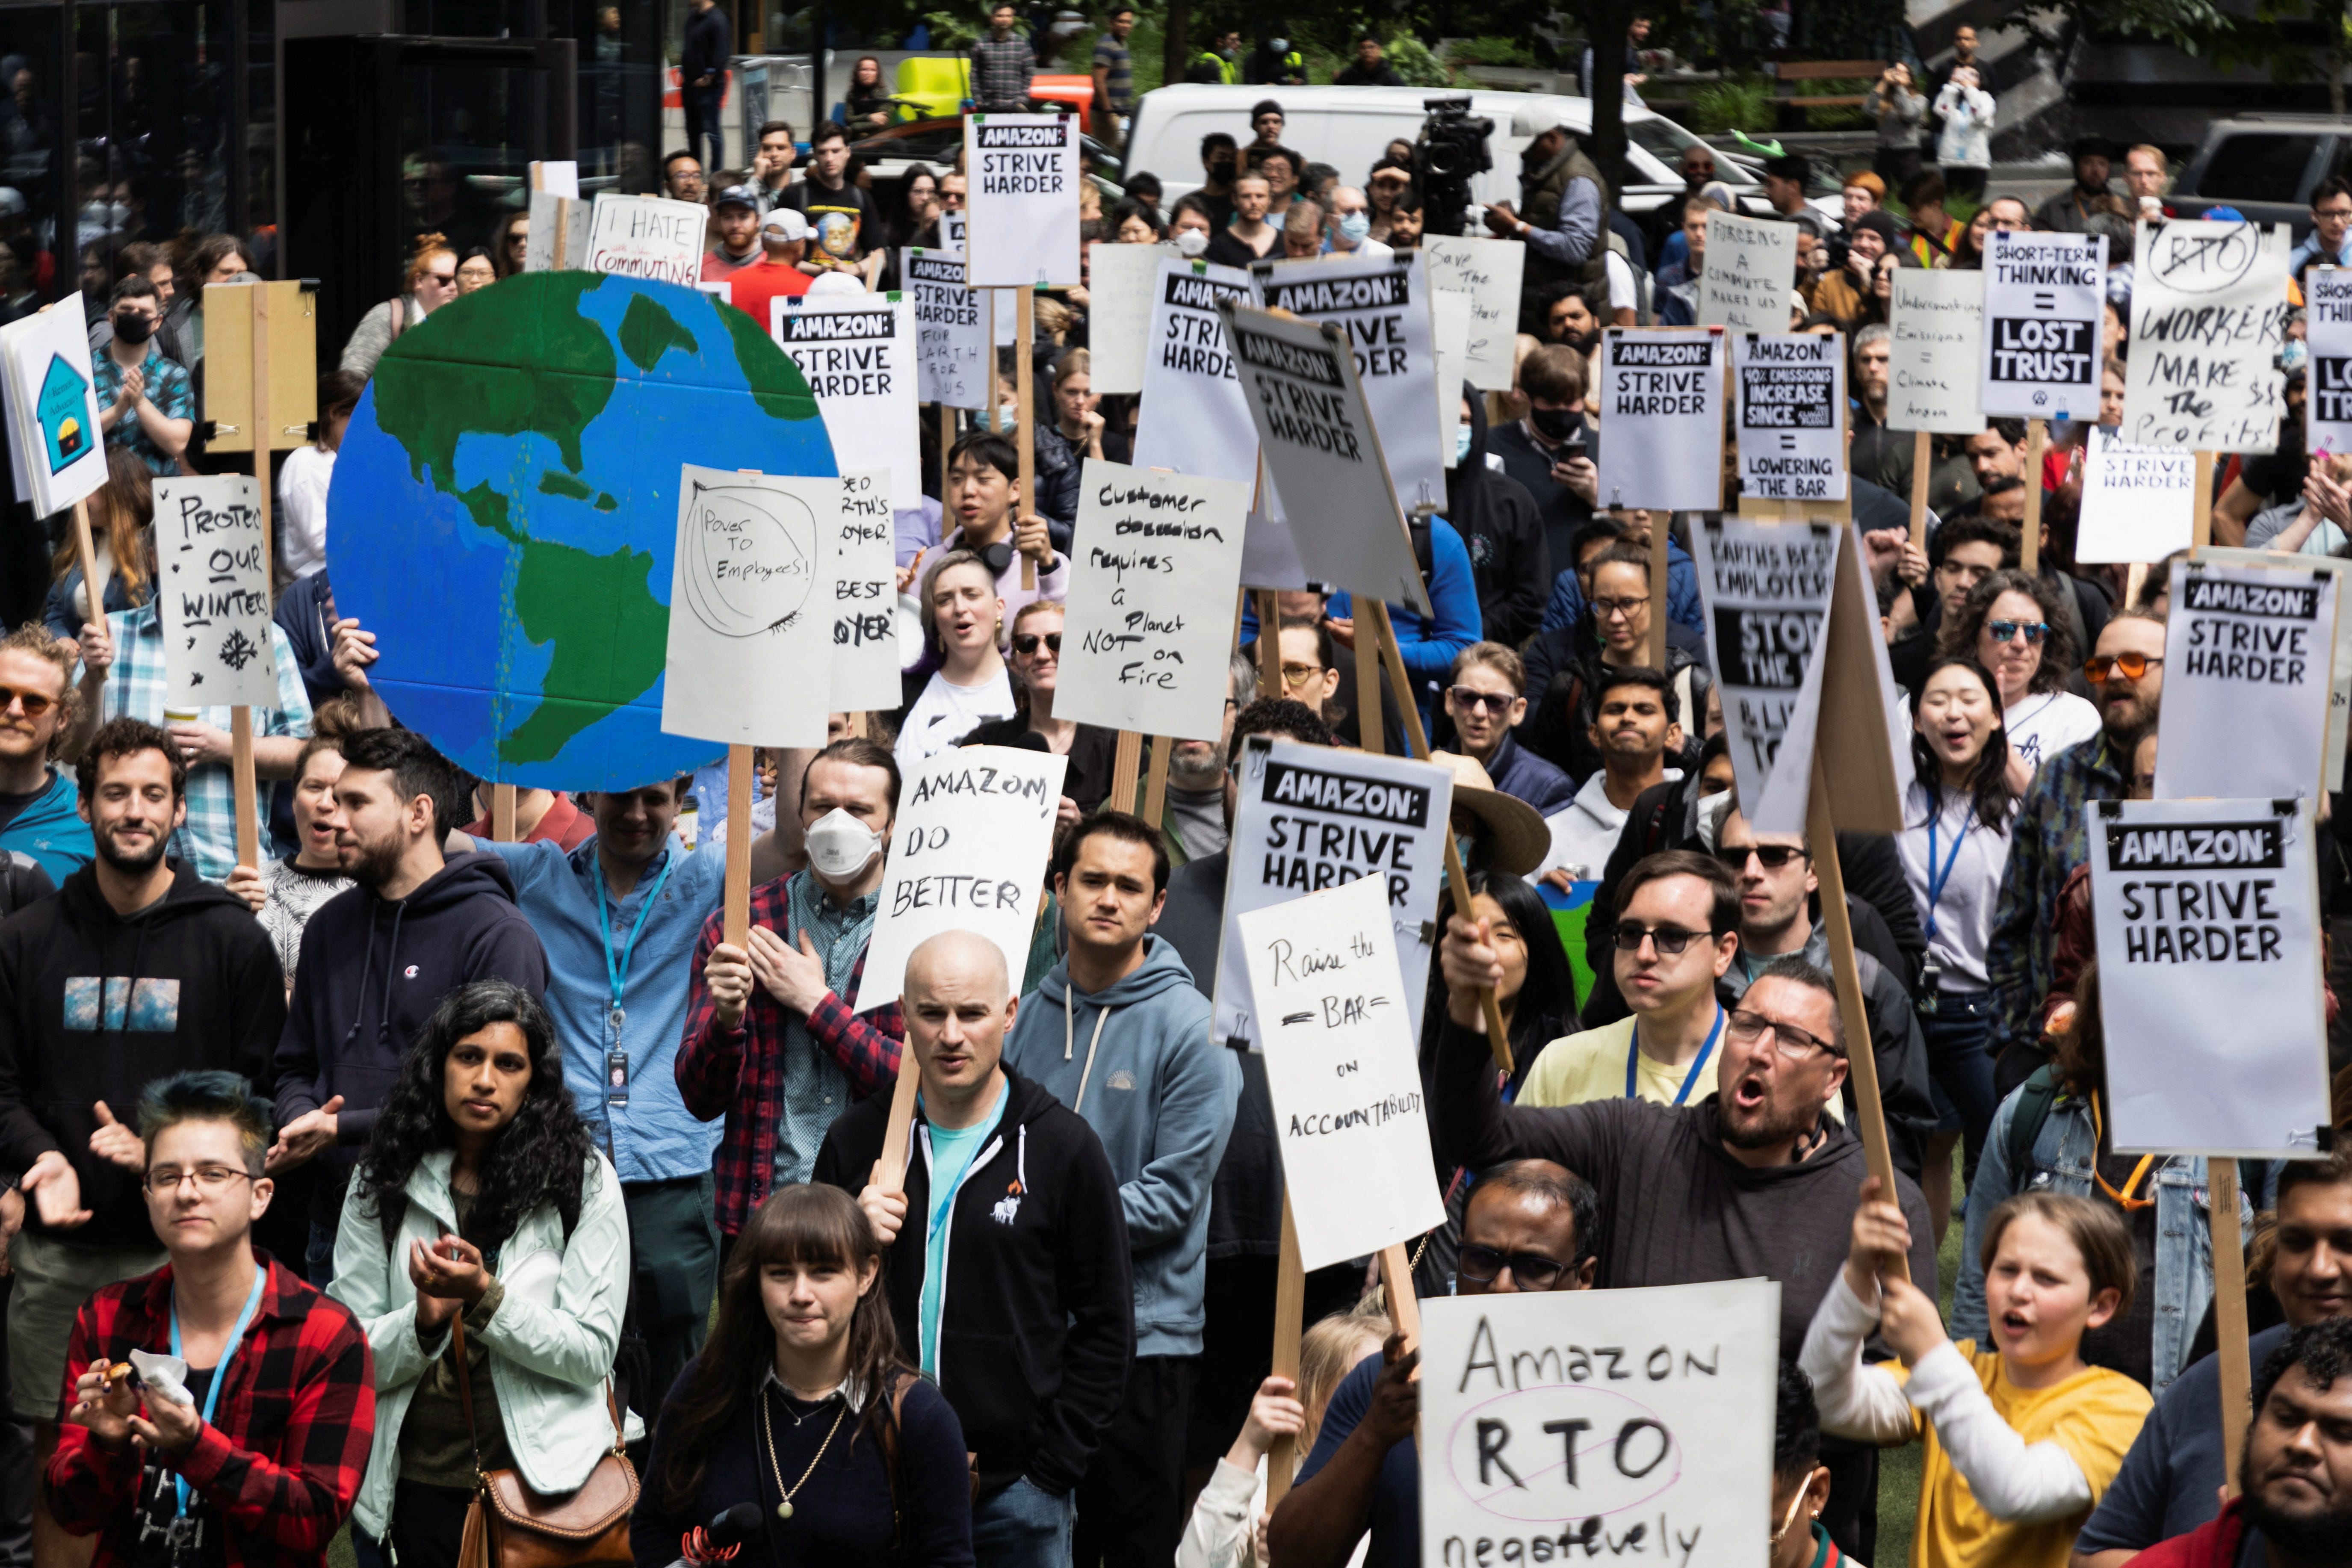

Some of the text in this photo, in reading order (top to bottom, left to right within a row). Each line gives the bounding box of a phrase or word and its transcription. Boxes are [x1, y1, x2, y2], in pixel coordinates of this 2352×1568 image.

[984, 127, 1063, 147] AMAZON:
[984, 153, 1063, 173] STRIVE
[984, 175, 1063, 194] HARDER
[610, 208, 694, 246] I HATE
[1714, 220, 1780, 245] FORCING
[1430, 242, 1471, 269] Save
[1736, 253, 1749, 271] A
[1995, 245, 2098, 263] SHORT-TERM
[2169, 231, 2246, 272] RTO
[914, 262, 966, 281] AMAZO
[1459, 269, 1490, 284] The
[1708, 266, 1779, 292] COMMUTE
[1995, 264, 2097, 286] THINKING
[915, 283, 978, 307] STRIVE
[1277, 275, 1400, 313] AMAZON:
[1711, 288, 1777, 308] MAKES US
[791, 314, 889, 340] AMAZON:
[915, 303, 978, 325] HARDER
[1727, 310, 1752, 328] ALL
[922, 328, 951, 344] FOR
[1167, 313, 1221, 348] STRI
[2002, 319, 2084, 351] LOST
[791, 345, 891, 372] STRIVE
[1163, 341, 1236, 379] HARDE
[1244, 332, 1336, 382] AMAZON:
[1619, 345, 1707, 364] AMAZON:
[1993, 351, 2091, 381] TRUST
[930, 363, 957, 374] FOR
[1618, 372, 1706, 392] STRIVE
[1770, 368, 1832, 384] EMISSIONS
[2147, 351, 2241, 387] MAKE
[811, 373, 892, 398] ARDER
[944, 381, 965, 396] US
[1749, 384, 1827, 404] INCREASE
[1255, 370, 1355, 430] STRIVE
[1616, 395, 1705, 415] HARDER
[2163, 390, 2219, 418] The
[1747, 405, 1796, 426] SINCE
[1265, 406, 1363, 463] HARDER
[1749, 457, 1833, 475] LOWERING
[2106, 459, 2192, 472] STRIVE
[1757, 478, 1826, 496] THE BAR
[2104, 475, 2190, 488] HARDER
[842, 495, 888, 516] RTH'S
[1099, 484, 1206, 513] Customer
[727, 537, 753, 551] TO
[209, 544, 262, 573] OUR
[1091, 547, 1173, 583] requires
[836, 580, 888, 599] BEST
[2194, 583, 2310, 617] AMAZON:
[833, 605, 896, 647] OYER"
[1125, 610, 1185, 633] Planet
[1083, 629, 1184, 664] NOT on
[2188, 619, 2308, 656] STRIVE
[1119, 661, 1178, 689] Fire
[1742, 653, 1795, 687] THE
[2186, 650, 2306, 685] HARDER
[1274, 770, 1420, 820] AMAZON:
[904, 825, 950, 857] DO
[1266, 815, 1415, 872] STRIVE
[2122, 827, 2274, 864] AMAZON:
[1263, 853, 1410, 907] HARDR
[891, 875, 1021, 918] BETTER
[2122, 877, 2281, 921] STRIVE
[2126, 925, 2283, 964] HARDER
[1268, 932, 1375, 987] Raise the
[1337, 1060, 1359, 1077] ON
[1289, 1093, 1421, 1137] ACCOUNTABILITY
[1476, 1416, 1671, 1491] RTO
